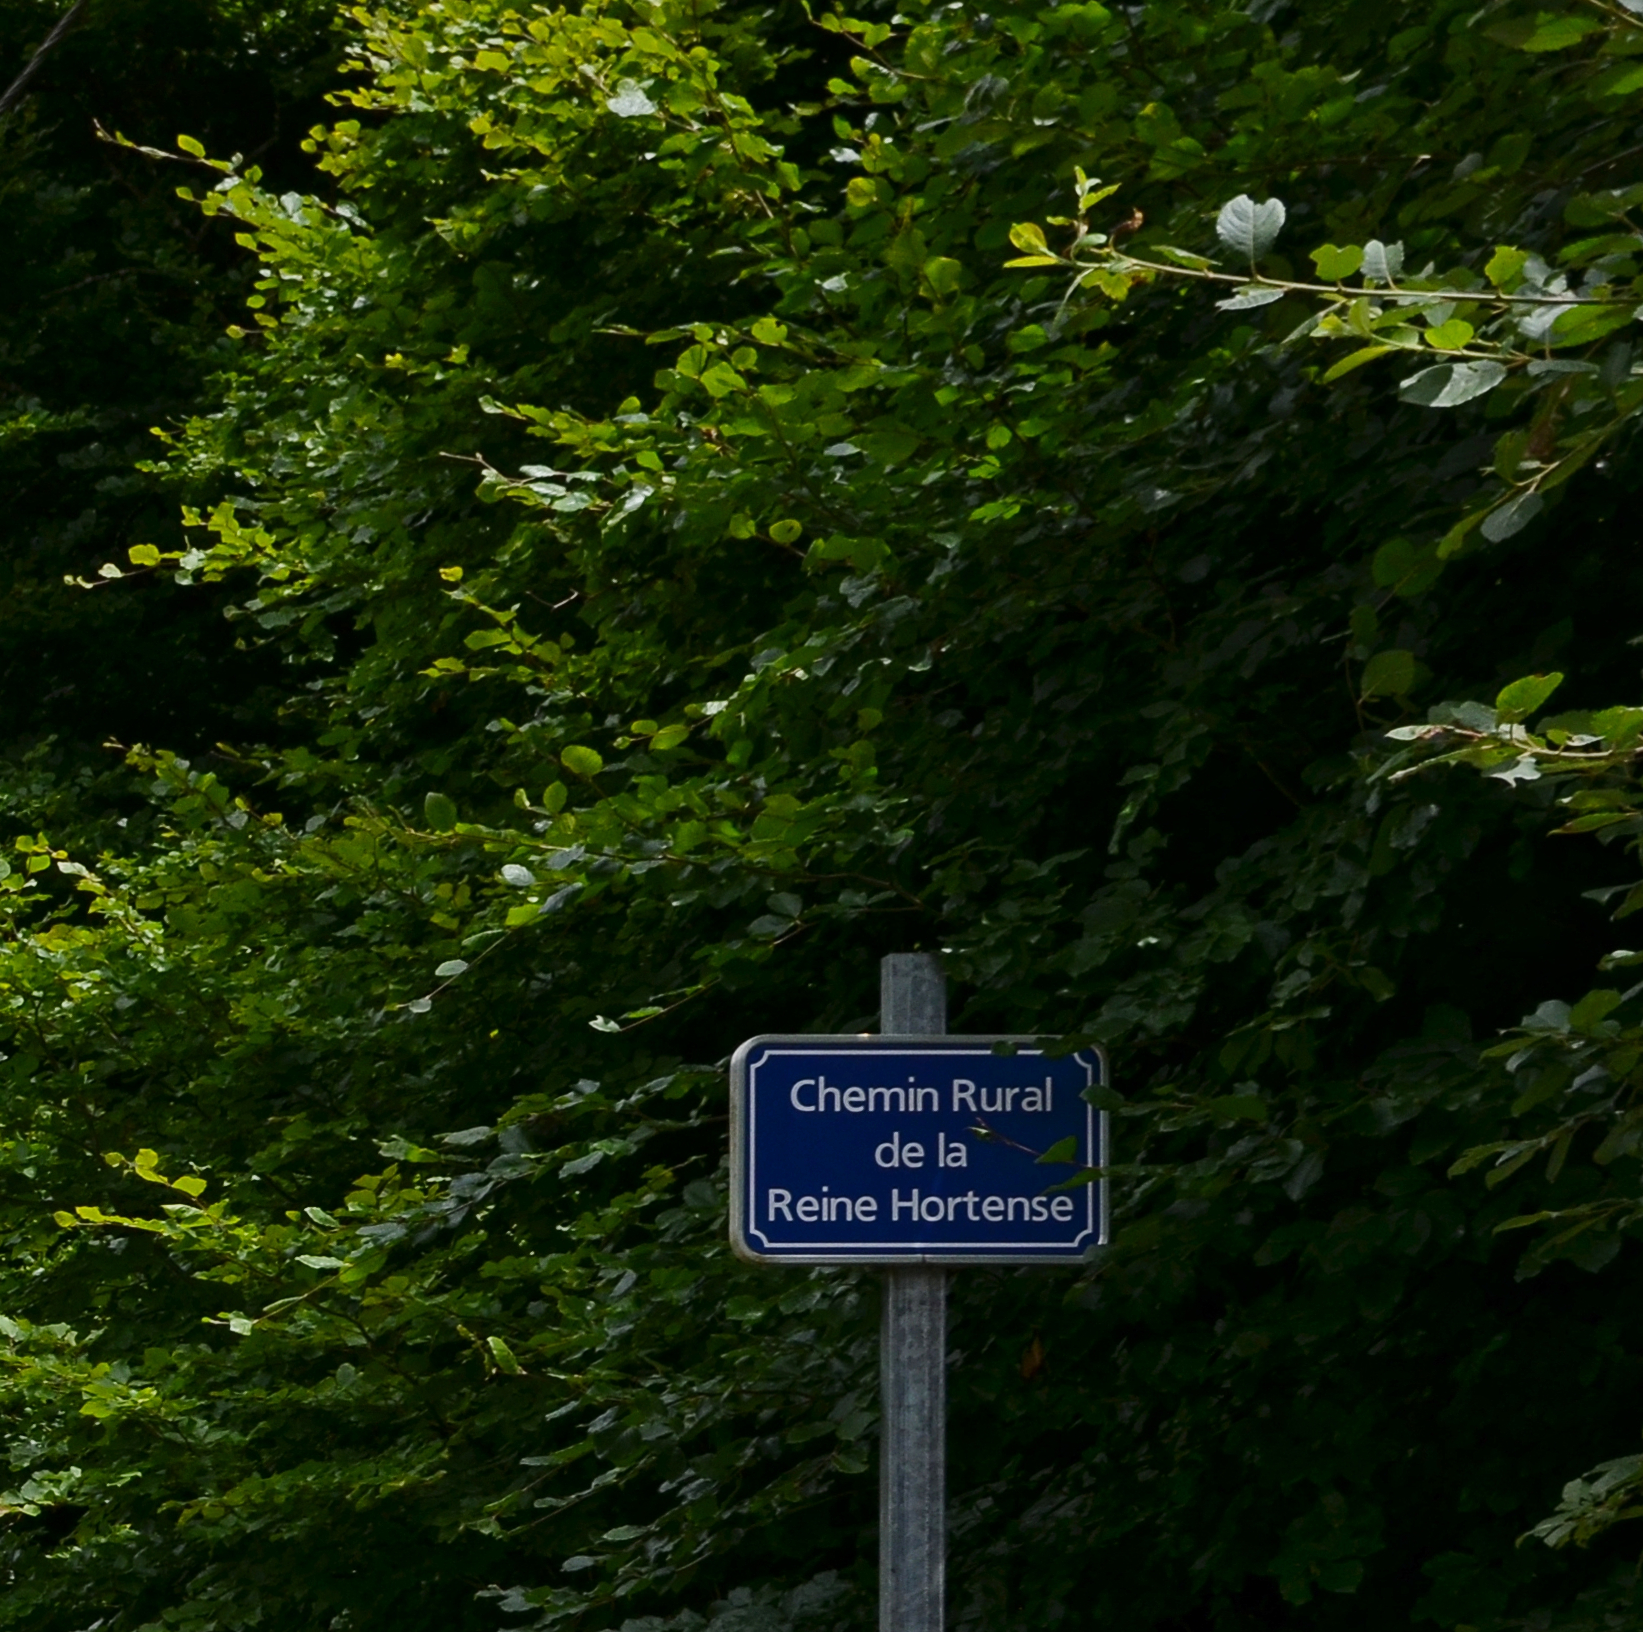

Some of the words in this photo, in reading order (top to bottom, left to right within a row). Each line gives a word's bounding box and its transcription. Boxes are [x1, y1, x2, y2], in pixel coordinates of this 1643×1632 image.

[790, 1076, 939, 1112] Chemin
[953, 1076, 1052, 1112] Rural
[874, 1131, 925, 1168] de
[938, 1132, 968, 1168] la
[768, 1186, 878, 1222] Reine
[891, 1188, 1074, 1222] Hortense
